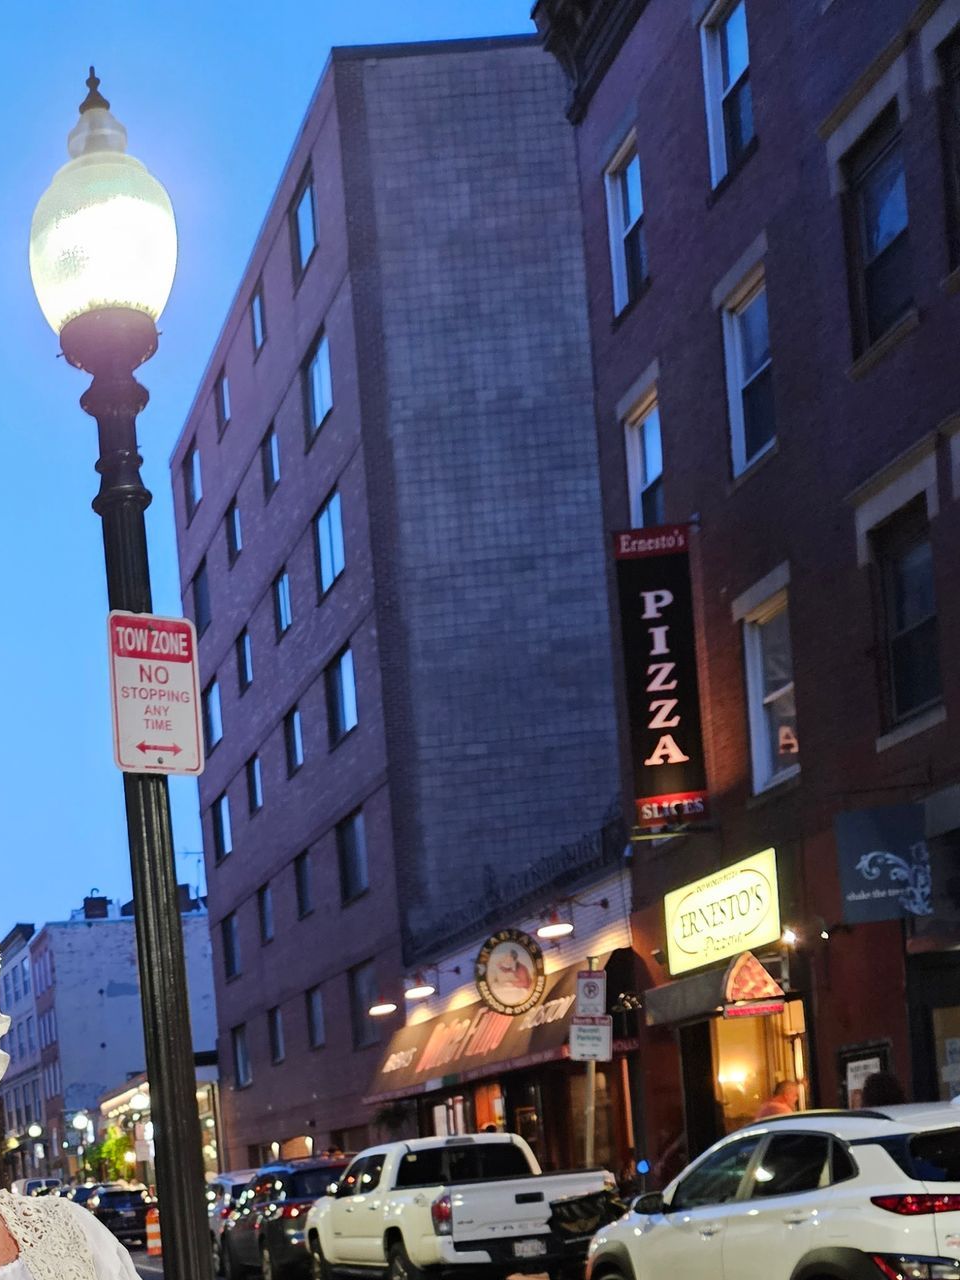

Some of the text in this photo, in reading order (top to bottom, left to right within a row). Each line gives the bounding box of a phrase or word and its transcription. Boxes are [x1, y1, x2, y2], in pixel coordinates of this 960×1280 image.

[619, 530, 685, 554] Ernesto's
[116, 626, 189, 657] TOW ZONE
[139, 664, 170, 685] NO
[640, 589, 690, 766] PIZZA
[121, 686, 190, 703] STOPPING
[144, 705, 170, 717] ANY
[143, 719, 173, 731] TIME
[641, 797, 705, 820] SLICES
[680, 883, 765, 940] ERNESTO'S
